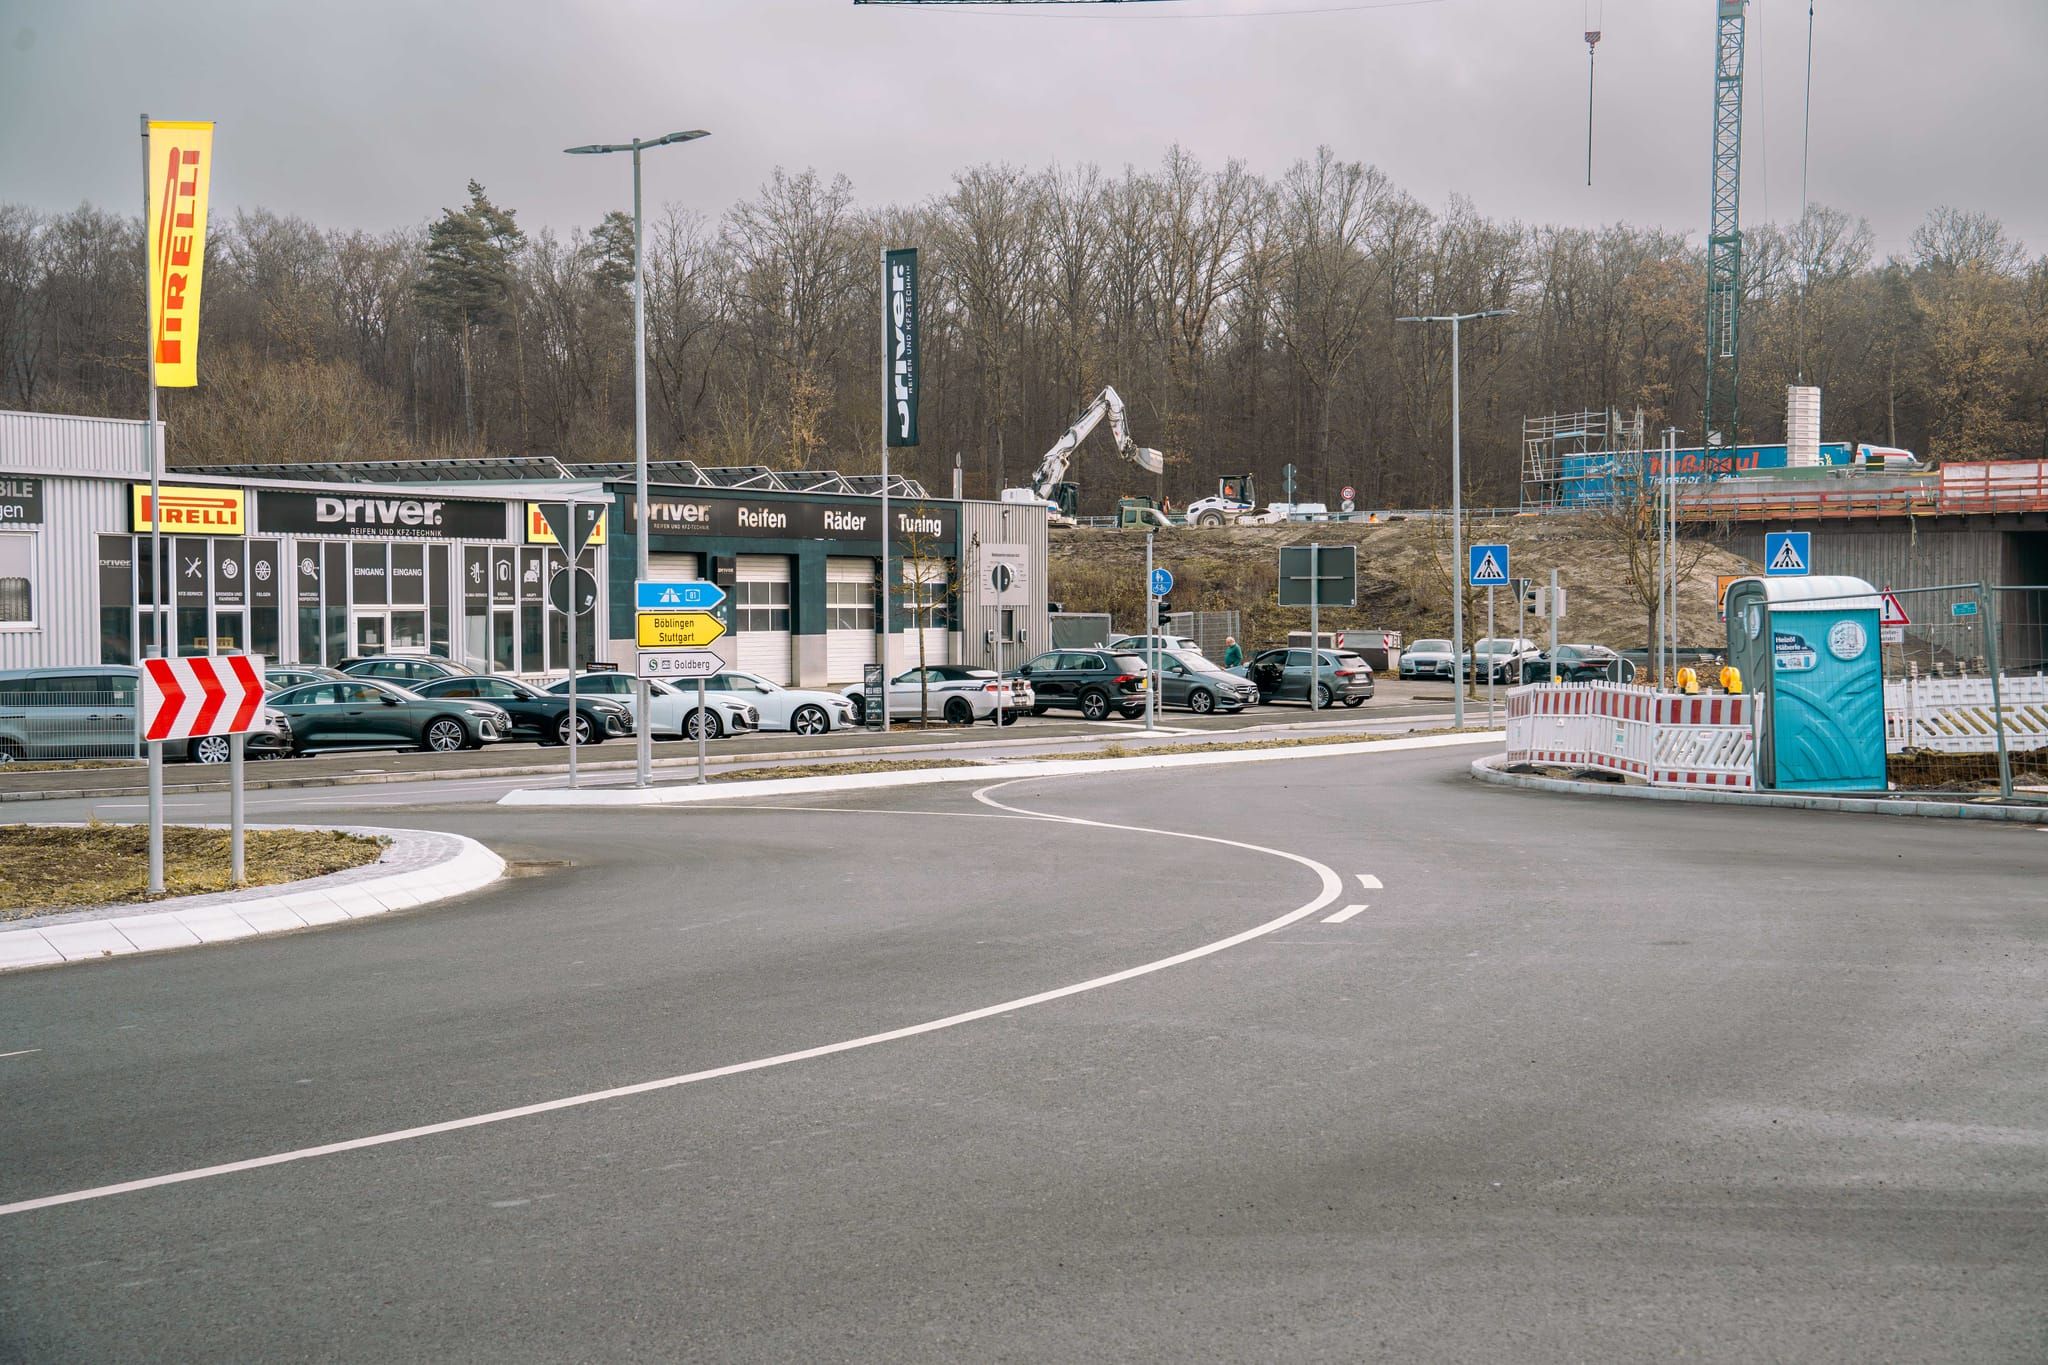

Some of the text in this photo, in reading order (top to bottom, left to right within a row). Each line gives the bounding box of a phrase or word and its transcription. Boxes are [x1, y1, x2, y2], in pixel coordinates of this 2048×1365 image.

[155, 147, 200, 363] PIRELLI
[738, 507, 787, 528] Reifen
[824, 510, 867, 531] Räder
[898, 513, 942, 537] Tuning
[350, 527, 442, 537] REIFEN UND KFZ-TECHNIK
[354, 567, 385, 576] EINGANG
[393, 568, 423, 577] EINGANG
[654, 618, 694, 629] Böblingen
[659, 632, 694, 643] Stuttgart
[674, 660, 710, 670] Goldberg
